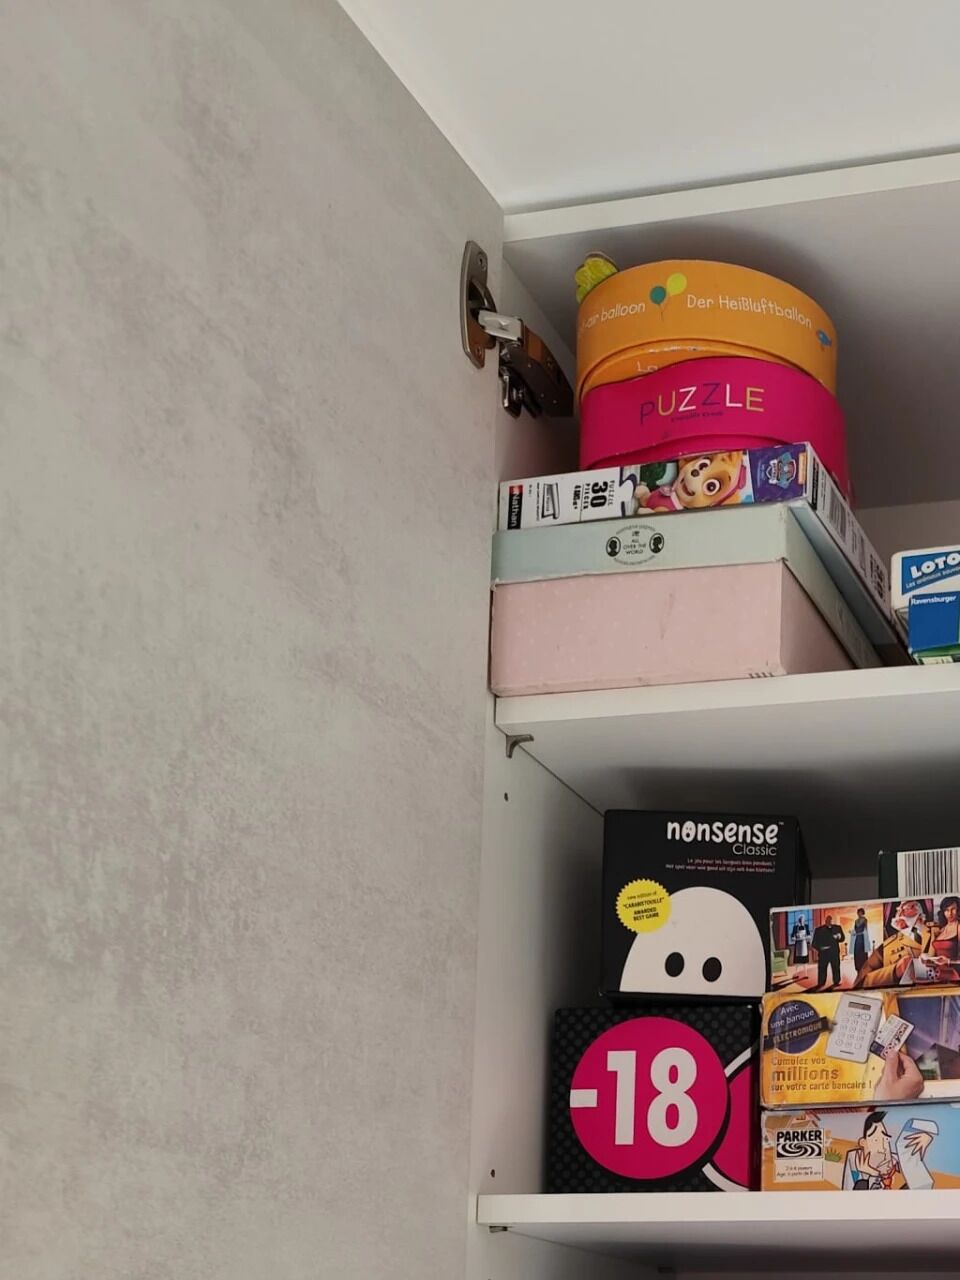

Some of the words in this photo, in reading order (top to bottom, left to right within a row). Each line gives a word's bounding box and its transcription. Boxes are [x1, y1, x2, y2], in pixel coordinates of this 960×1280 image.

[601, 302, 646, 322] balloon
[686, 294, 714, 309] Der
[718, 296, 812, 328] Heißluftballon
[639, 382, 765, 425] PUZZLE
[590, 481, 609, 509] 30
[509, 491, 522, 527] Nathan
[910, 595, 957, 605] Ravensburger
[667, 821, 778, 844] nonsense
[732, 843, 777, 856] Classic
[780, 1004, 799, 1016] Avec
[786, 1010, 815, 1025] banque
[772, 1066, 840, 1081] millions
[809, 1082, 829, 1090] carte
[832, 1080, 866, 1089] bancaire
[569, 1047, 698, 1148] -18
[776, 1130, 822, 1142] PARKER
